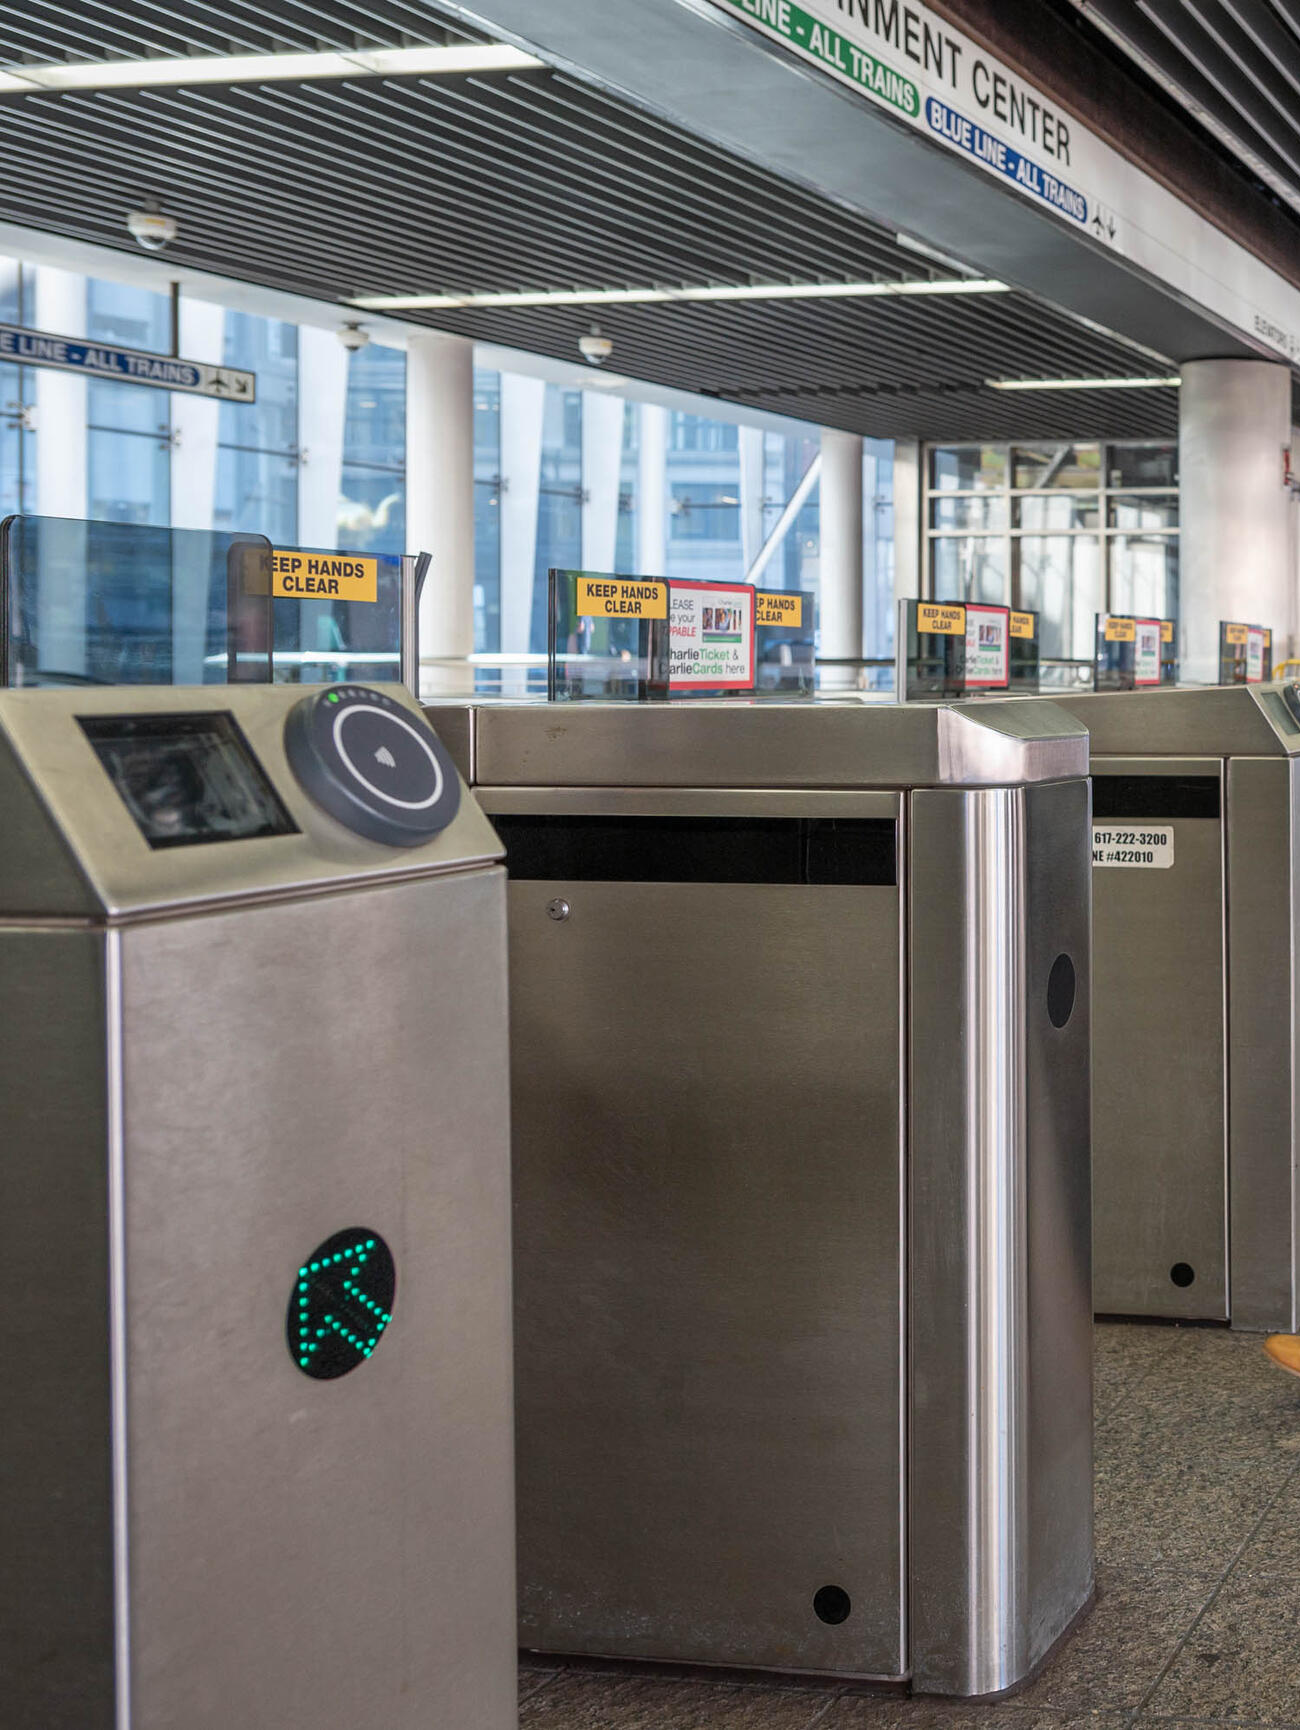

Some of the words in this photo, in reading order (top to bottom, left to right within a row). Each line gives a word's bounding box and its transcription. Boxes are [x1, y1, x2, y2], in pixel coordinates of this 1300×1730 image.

[809, 22, 847, 70] ALL
[849, 47, 915, 113] TRAINS
[972, 60, 1071, 167] CENTER
[930, 100, 972, 149] BLUE
[974, 128, 1008, 171] LINE
[1015, 158, 1041, 193] ALL
[1042, 175, 1085, 220] TRAINS
[17, 335, 67, 361] LINE
[84, 349, 123, 373] ALL
[125, 357, 196, 385] TRAINS
[307, 559, 365, 579] HANDS
[282, 575, 340, 595] CLEAR
[586, 583, 618, 598] KEEP
[621, 585, 659, 601] HANDS
[604, 600, 642, 614] CLEAR
[670, 599, 695, 611] EASE
[766, 598, 796, 611] HANDS
[676, 613, 695, 625] your
[922, 607, 939, 618] KEEP
[940, 609, 961, 621] HANDS
[931, 620, 952, 631] CLEAR
[669, 648, 730, 662] harlieTicket
[732, 649, 739, 661] &
[725, 662, 745, 675] here
[1094, 832, 1168, 846] 617-222-3200
[1106, 851, 1154, 863] #422010
